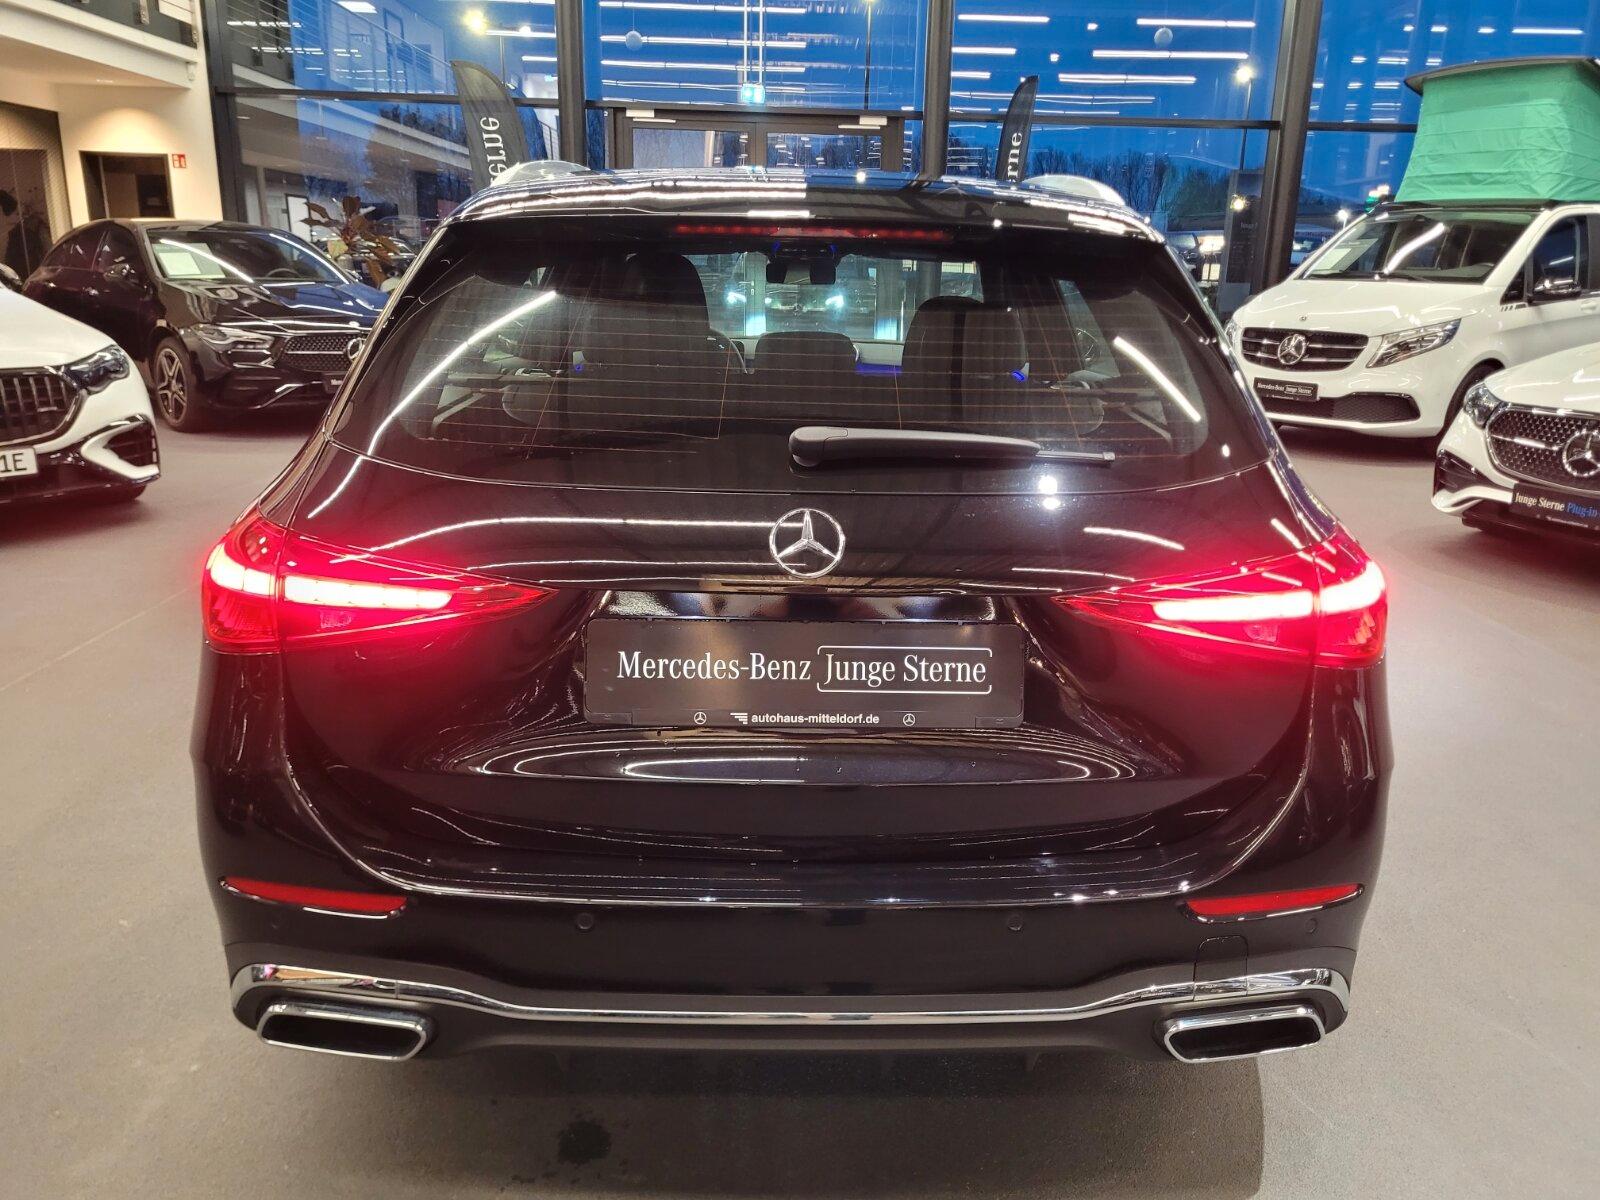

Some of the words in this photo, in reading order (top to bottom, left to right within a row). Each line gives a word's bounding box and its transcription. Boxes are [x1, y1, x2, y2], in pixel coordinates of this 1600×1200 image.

[1007, 132, 1022, 183] rne
[1515, 492, 1537, 507] Junge
[1538, 497, 1565, 511] Sterne
[617, 651, 812, 681] Mercedes-Benz
[824, 654, 896, 687] Junge
[902, 654, 986, 682] Sterne
[751, 713, 880, 725] autohaus-mitteldorf.de
